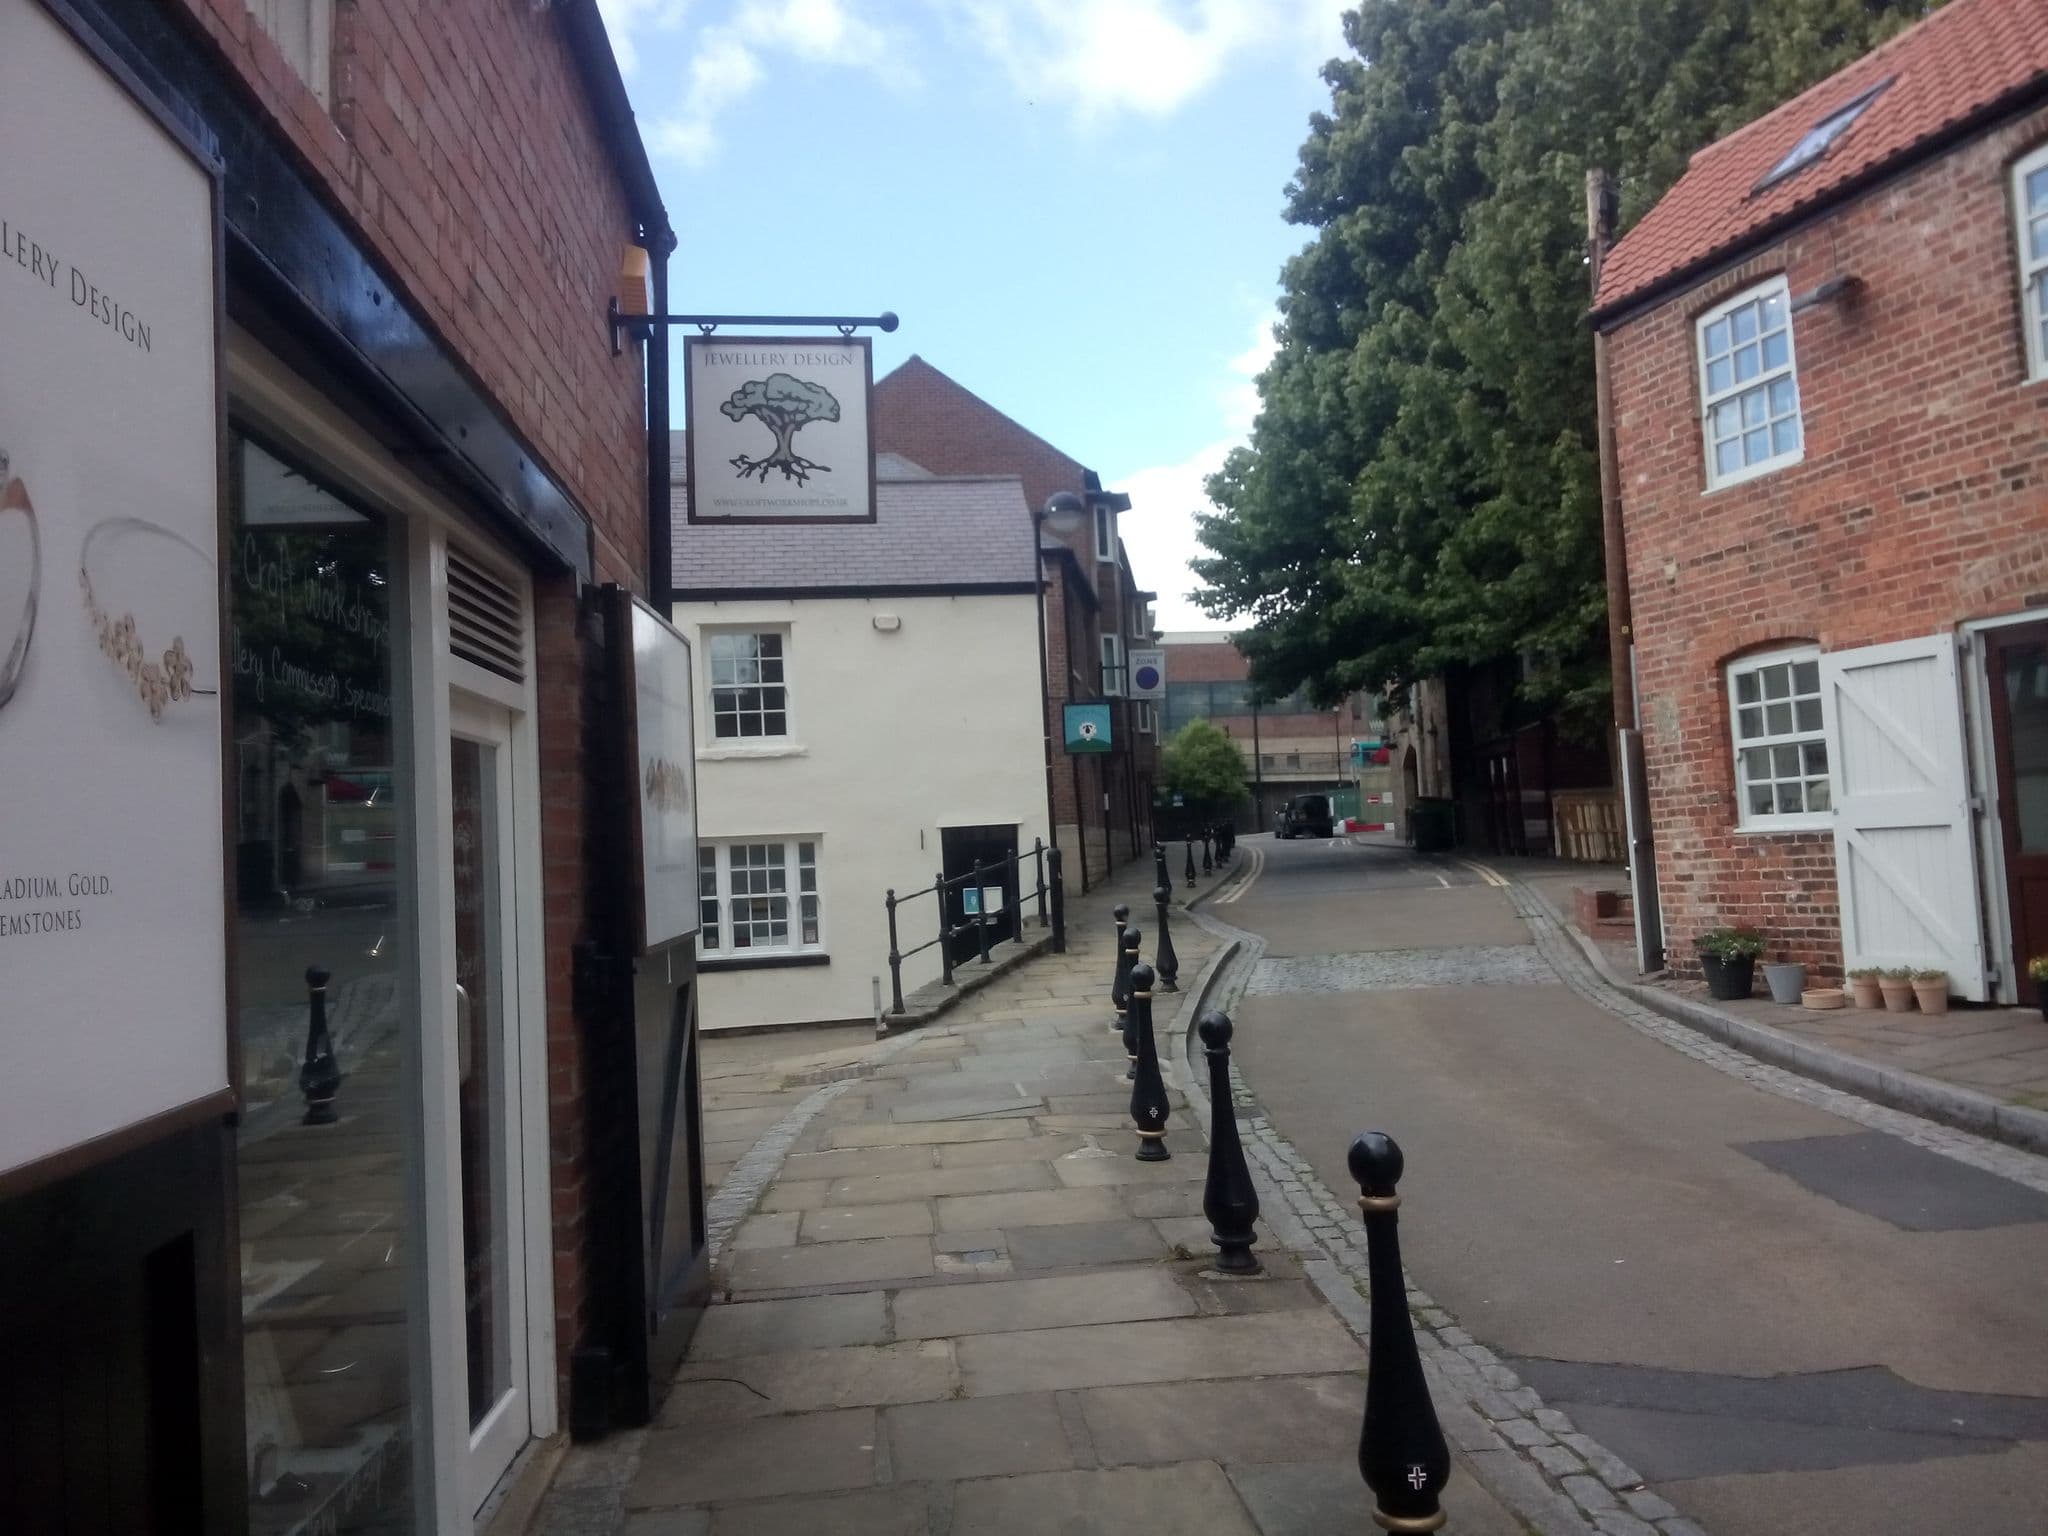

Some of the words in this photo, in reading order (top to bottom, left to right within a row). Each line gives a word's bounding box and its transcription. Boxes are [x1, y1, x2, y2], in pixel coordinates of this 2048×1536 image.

[71, 266, 151, 352] DESIGN
[704, 352, 786, 367] JEWELLERY
[794, 352, 854, 366] DESIGN
